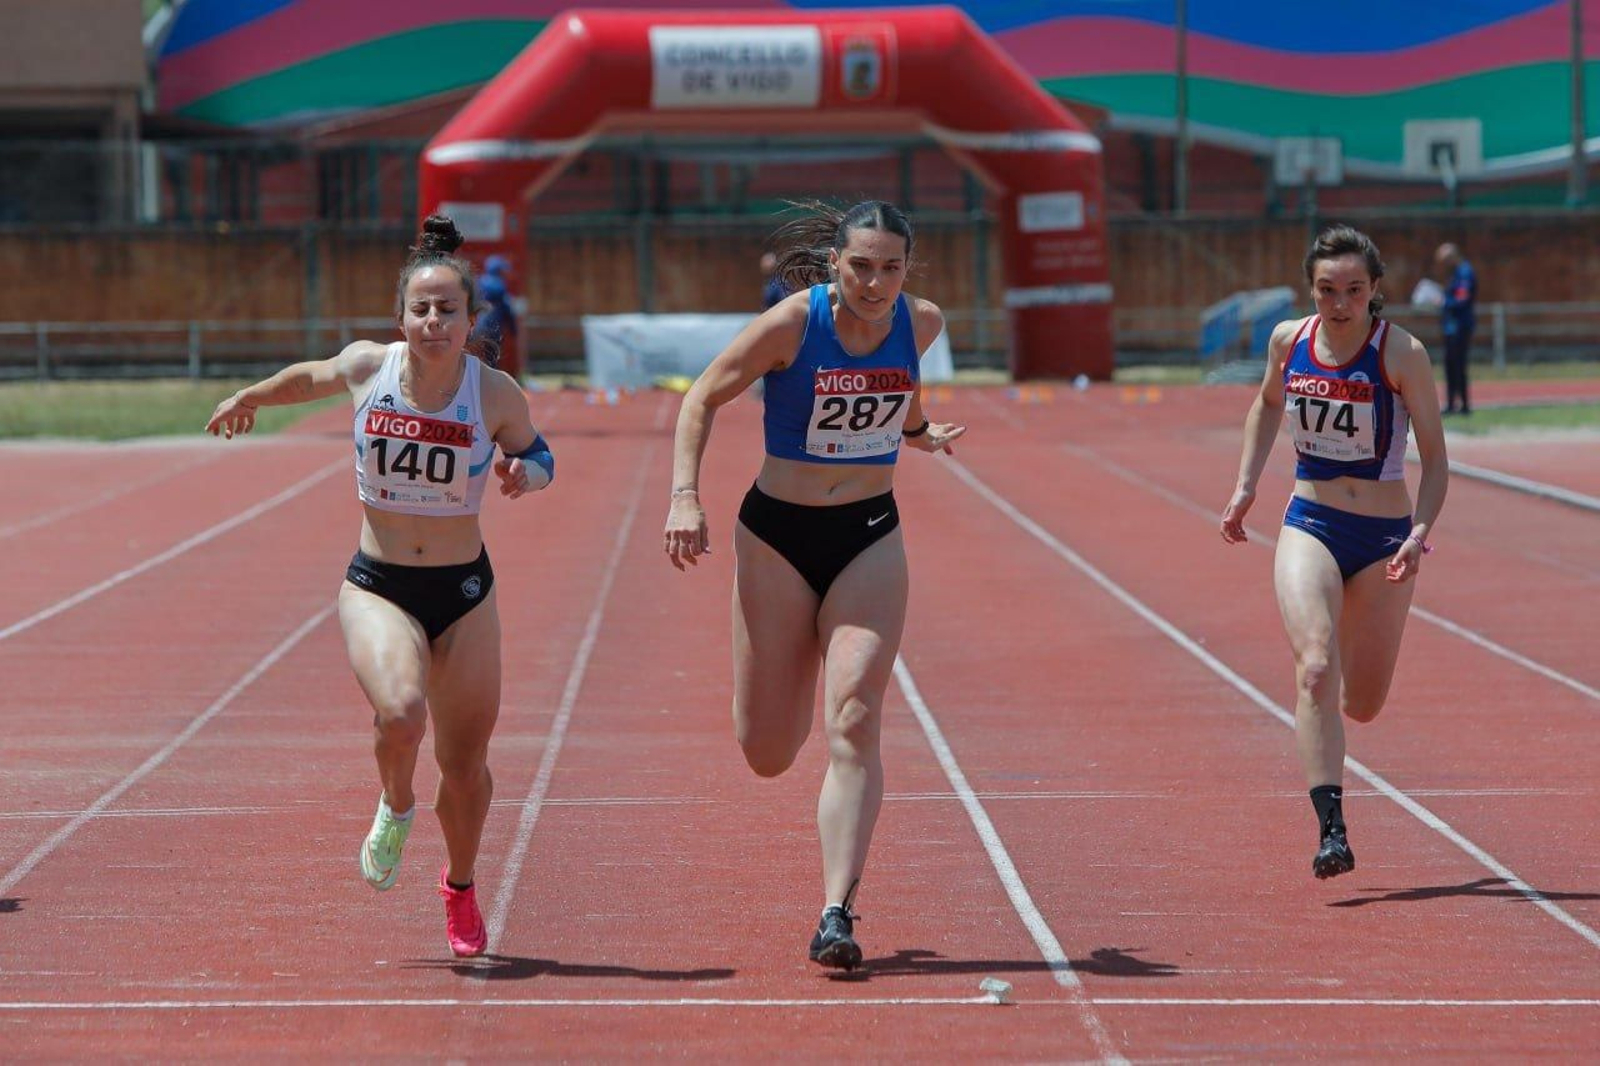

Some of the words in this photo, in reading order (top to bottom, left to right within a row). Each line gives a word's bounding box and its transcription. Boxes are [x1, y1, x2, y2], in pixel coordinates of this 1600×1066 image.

[665, 43, 807, 67] CONCELLO
[680, 70, 715, 94] DE
[725, 70, 793, 94] VIGO
[817, 394, 905, 432] 287
[1295, 397, 1359, 438] 174
[371, 438, 455, 484] 140
